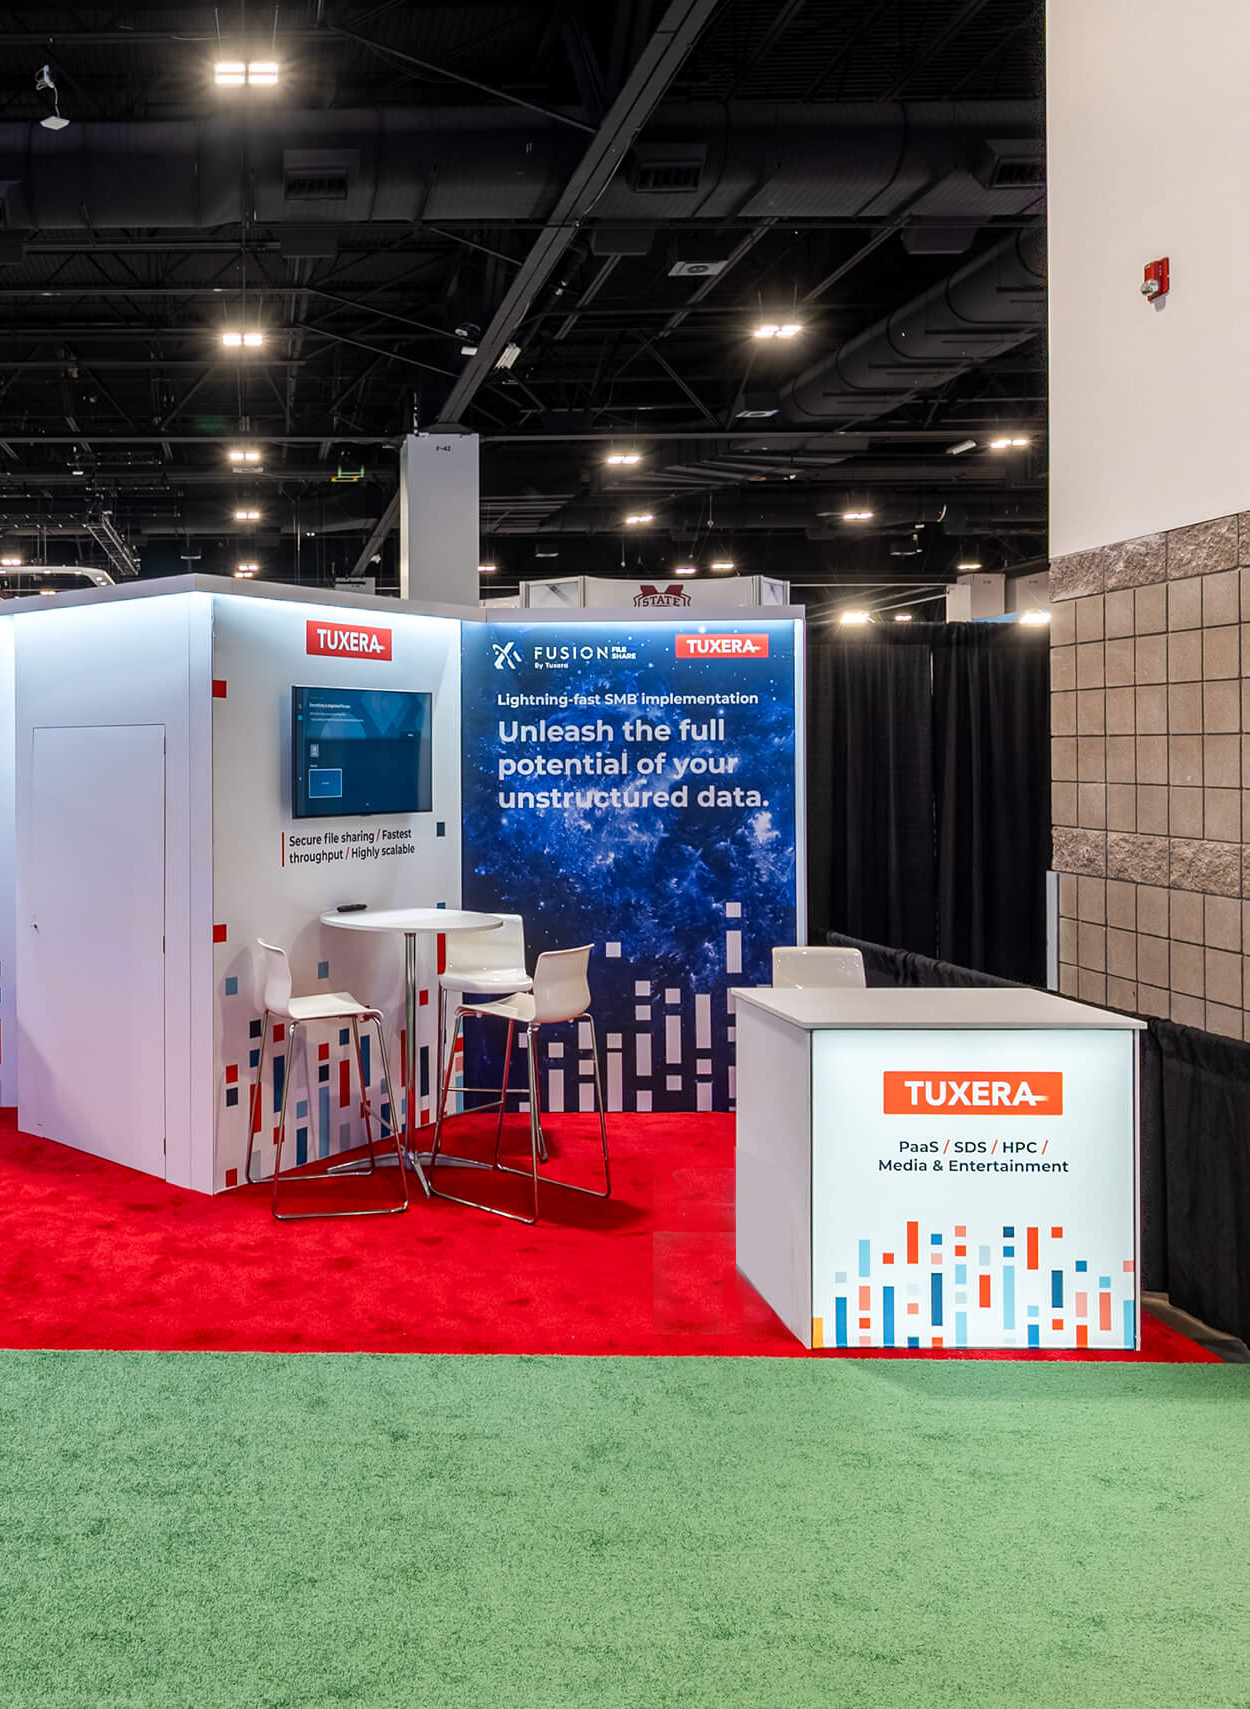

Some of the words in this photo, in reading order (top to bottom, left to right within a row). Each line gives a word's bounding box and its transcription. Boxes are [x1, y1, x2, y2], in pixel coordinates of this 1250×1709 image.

[642, 595, 681, 608] STATE
[316, 628, 386, 654] TUXERA
[686, 639, 761, 653] TUXERA
[534, 646, 609, 660] FUSION
[534, 662, 544, 670] By
[545, 661, 569, 669] Tuxera
[497, 693, 601, 709] Lightning-fast
[641, 692, 759, 708] implementation
[499, 719, 614, 742] Unleash
[622, 719, 671, 741] the
[679, 718, 725, 741] full
[498, 751, 628, 780] potential
[636, 751, 667, 775] of
[672, 756, 738, 779] your
[498, 785, 688, 809] unstructured
[697, 785, 769, 808] data.
[289, 835, 321, 847] Secure
[324, 832, 339, 845] file
[341, 830, 375, 844] sharing
[382, 828, 412, 841] Fastest
[289, 849, 344, 864] throughput
[351, 846, 380, 860] Highly
[381, 843, 415, 857] scalable
[904, 1081, 1049, 1106] TUXERA
[899, 1141, 939, 1153] PaaS
[954, 1141, 987, 1153] SDS
[1002, 1141, 1038, 1153] HPC
[878, 1158, 927, 1172] Media
[932, 1159, 944, 1172] &
[949, 1158, 1069, 1173] Entertainment
